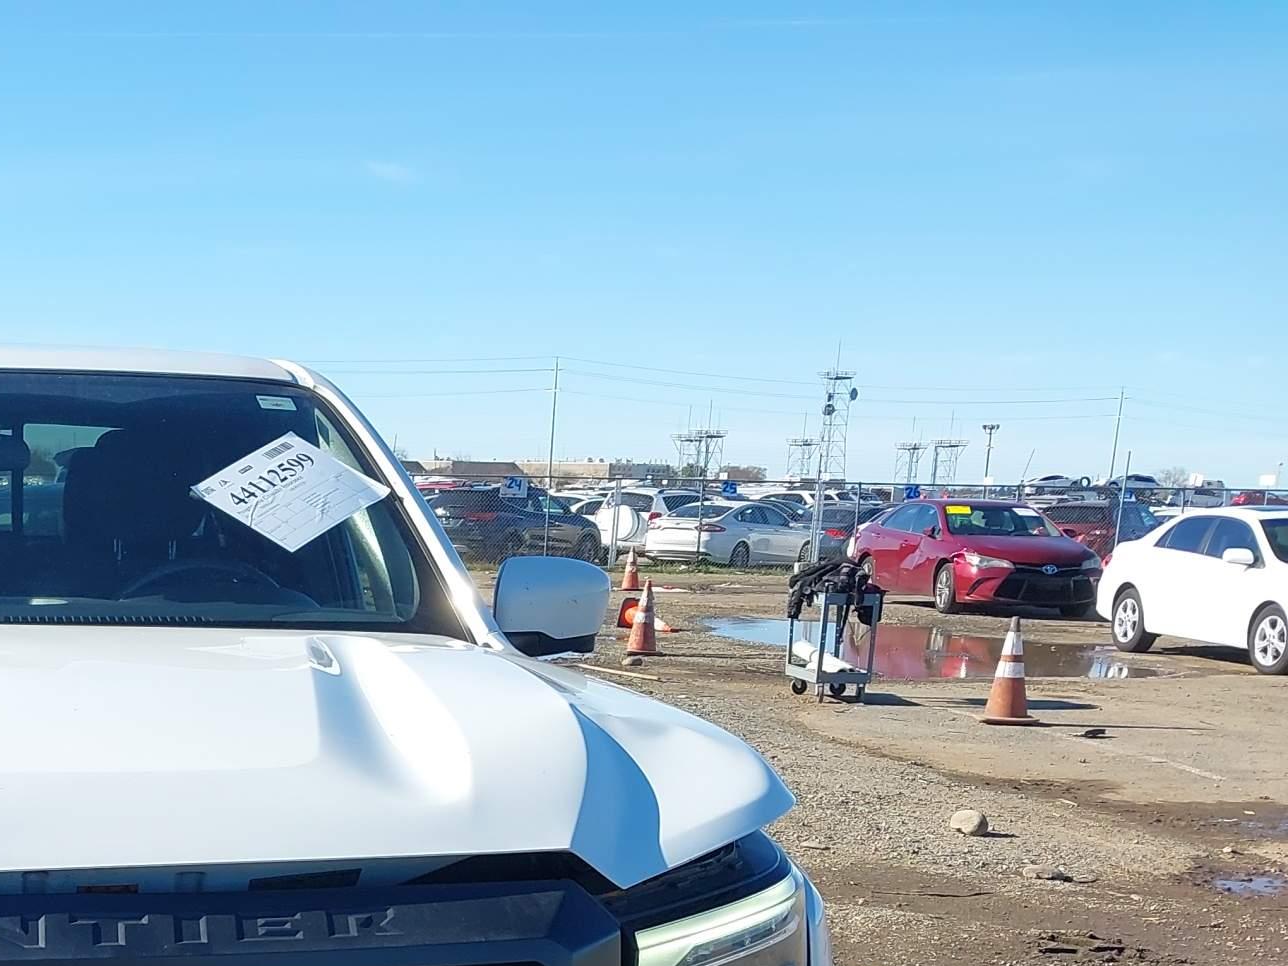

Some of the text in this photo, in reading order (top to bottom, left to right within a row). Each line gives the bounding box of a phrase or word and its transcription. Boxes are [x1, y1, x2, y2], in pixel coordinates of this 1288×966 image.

[229, 452, 315, 506] 44112599
[507, 476, 522, 491] 24
[722, 480, 737, 494] 25
[904, 485, 921, 499] 26
